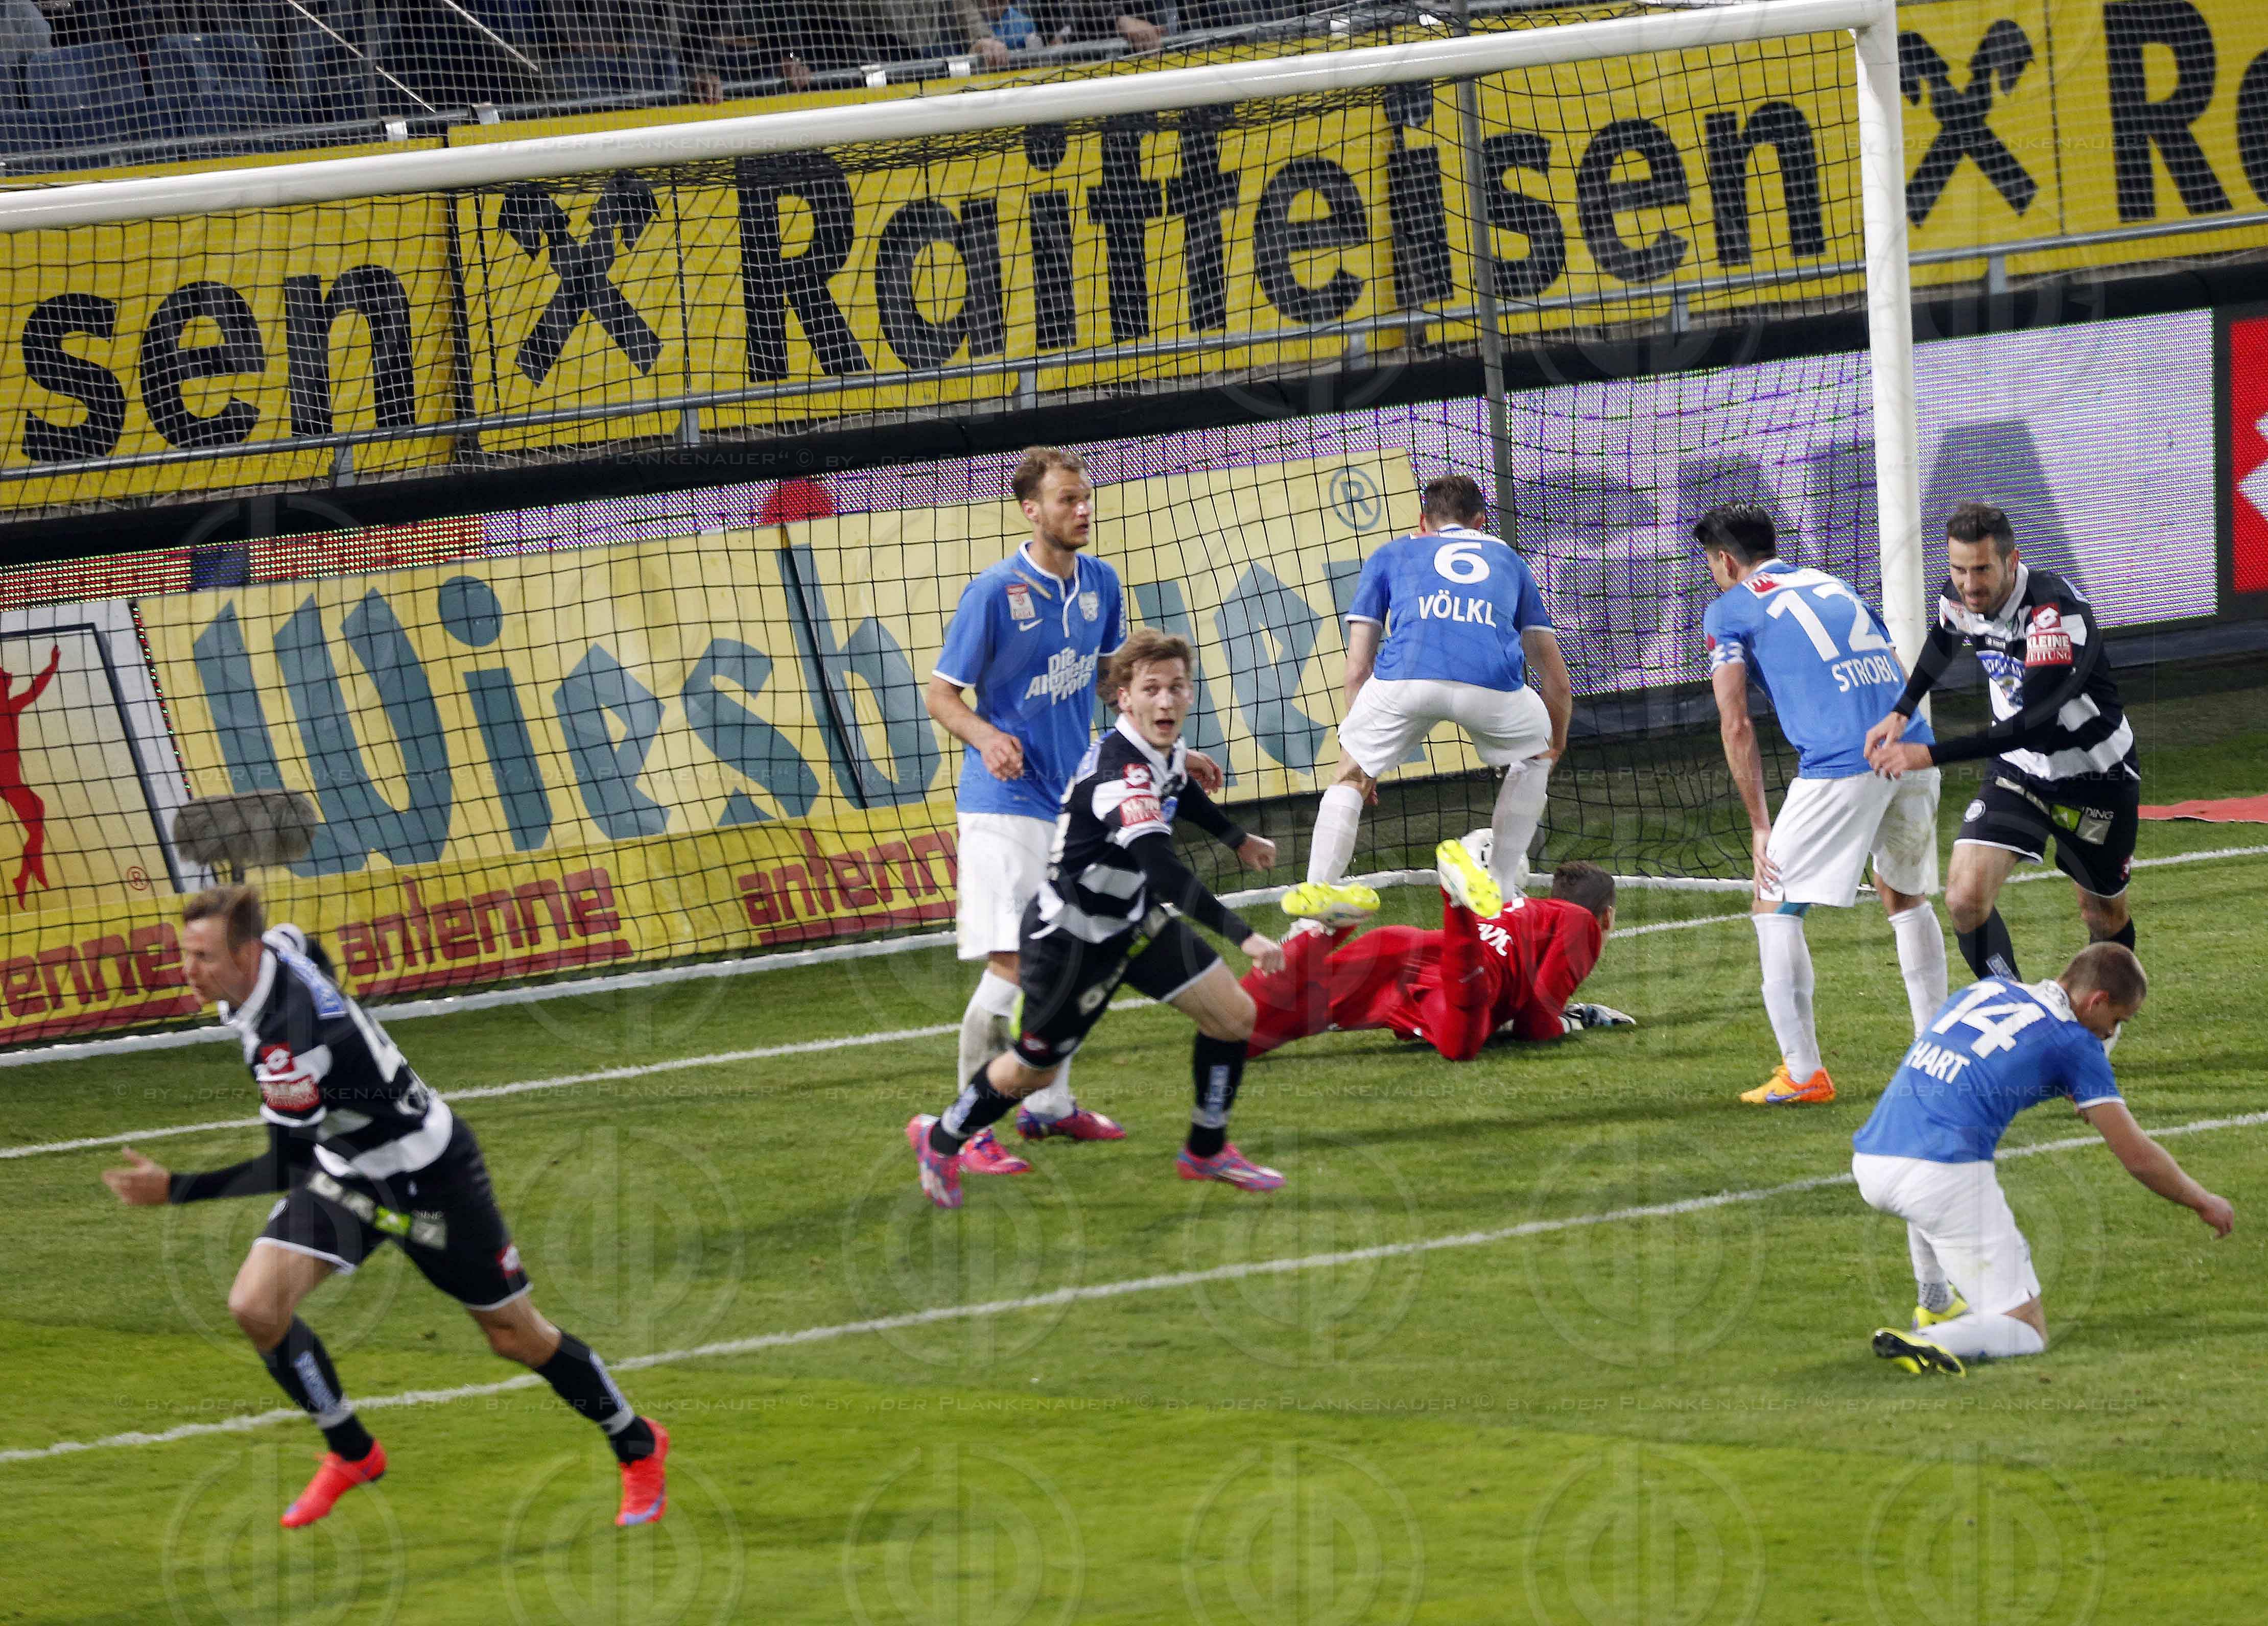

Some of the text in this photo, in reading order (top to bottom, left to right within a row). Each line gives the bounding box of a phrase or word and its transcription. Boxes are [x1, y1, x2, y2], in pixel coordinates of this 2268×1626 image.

[2103, 0, 2268, 222] R
[737, 83, 1825, 382] Raiffeisen
[1418, 589, 1497, 629] VÖLKL
[1433, 541, 1490, 584] 6
[1766, 581, 1888, 662] 12
[337, 868, 621, 976] antenne
[738, 828, 959, 925] antenn
[0, 923, 189, 1017] enne
[1931, 981, 2047, 1060] 14
